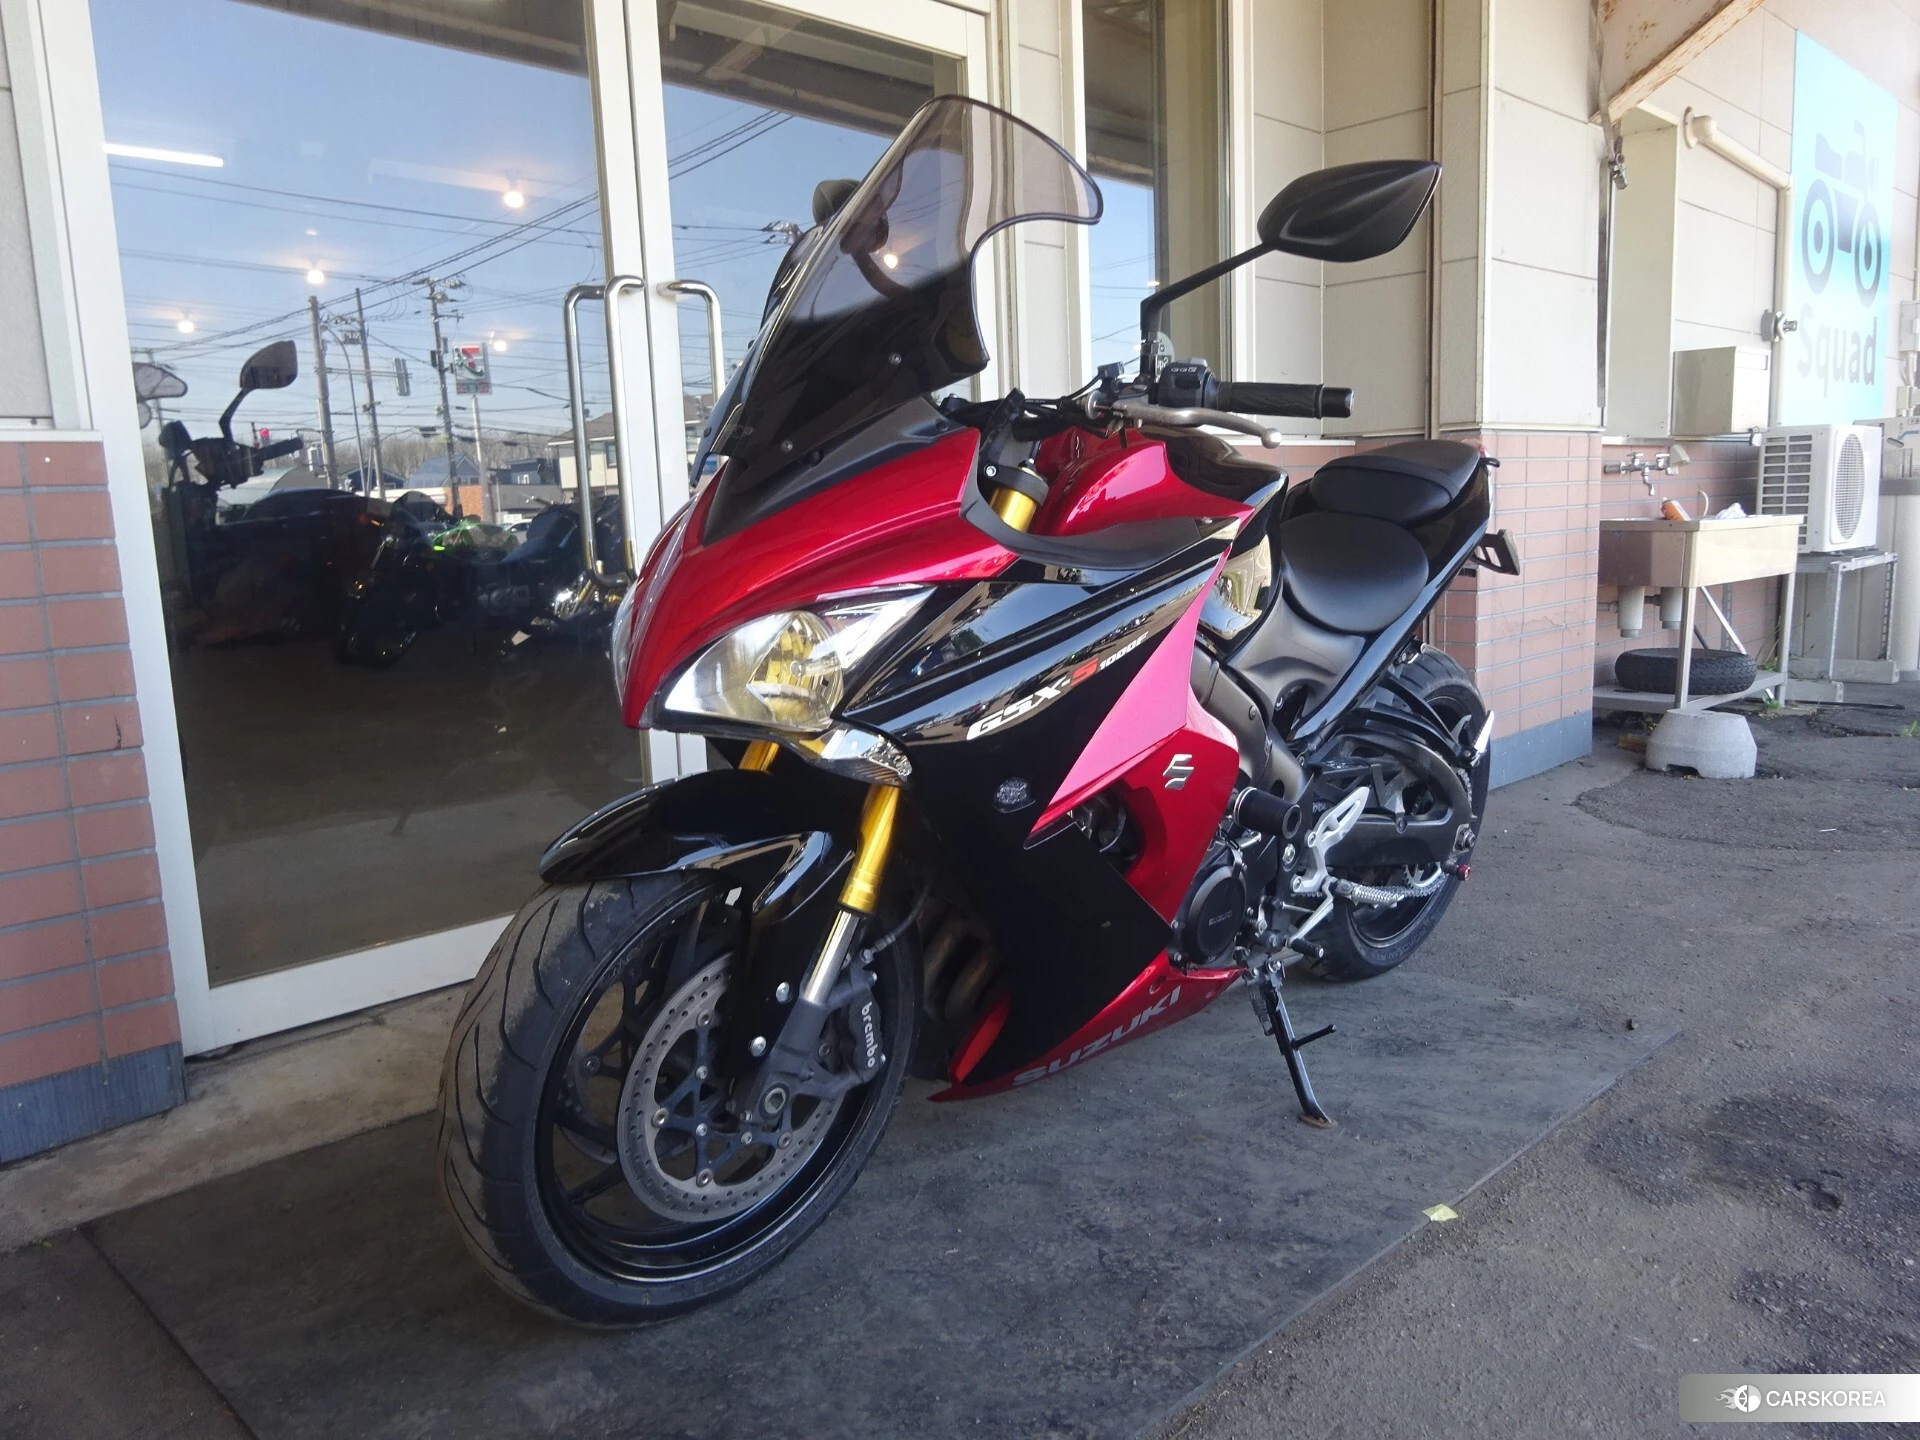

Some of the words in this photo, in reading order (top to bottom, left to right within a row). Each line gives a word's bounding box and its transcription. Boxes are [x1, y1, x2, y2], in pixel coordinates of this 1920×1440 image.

[1797, 302, 1878, 399] Squad
[861, 1001, 878, 1068] brembo
[1012, 985, 1181, 1086] SUZUKI
